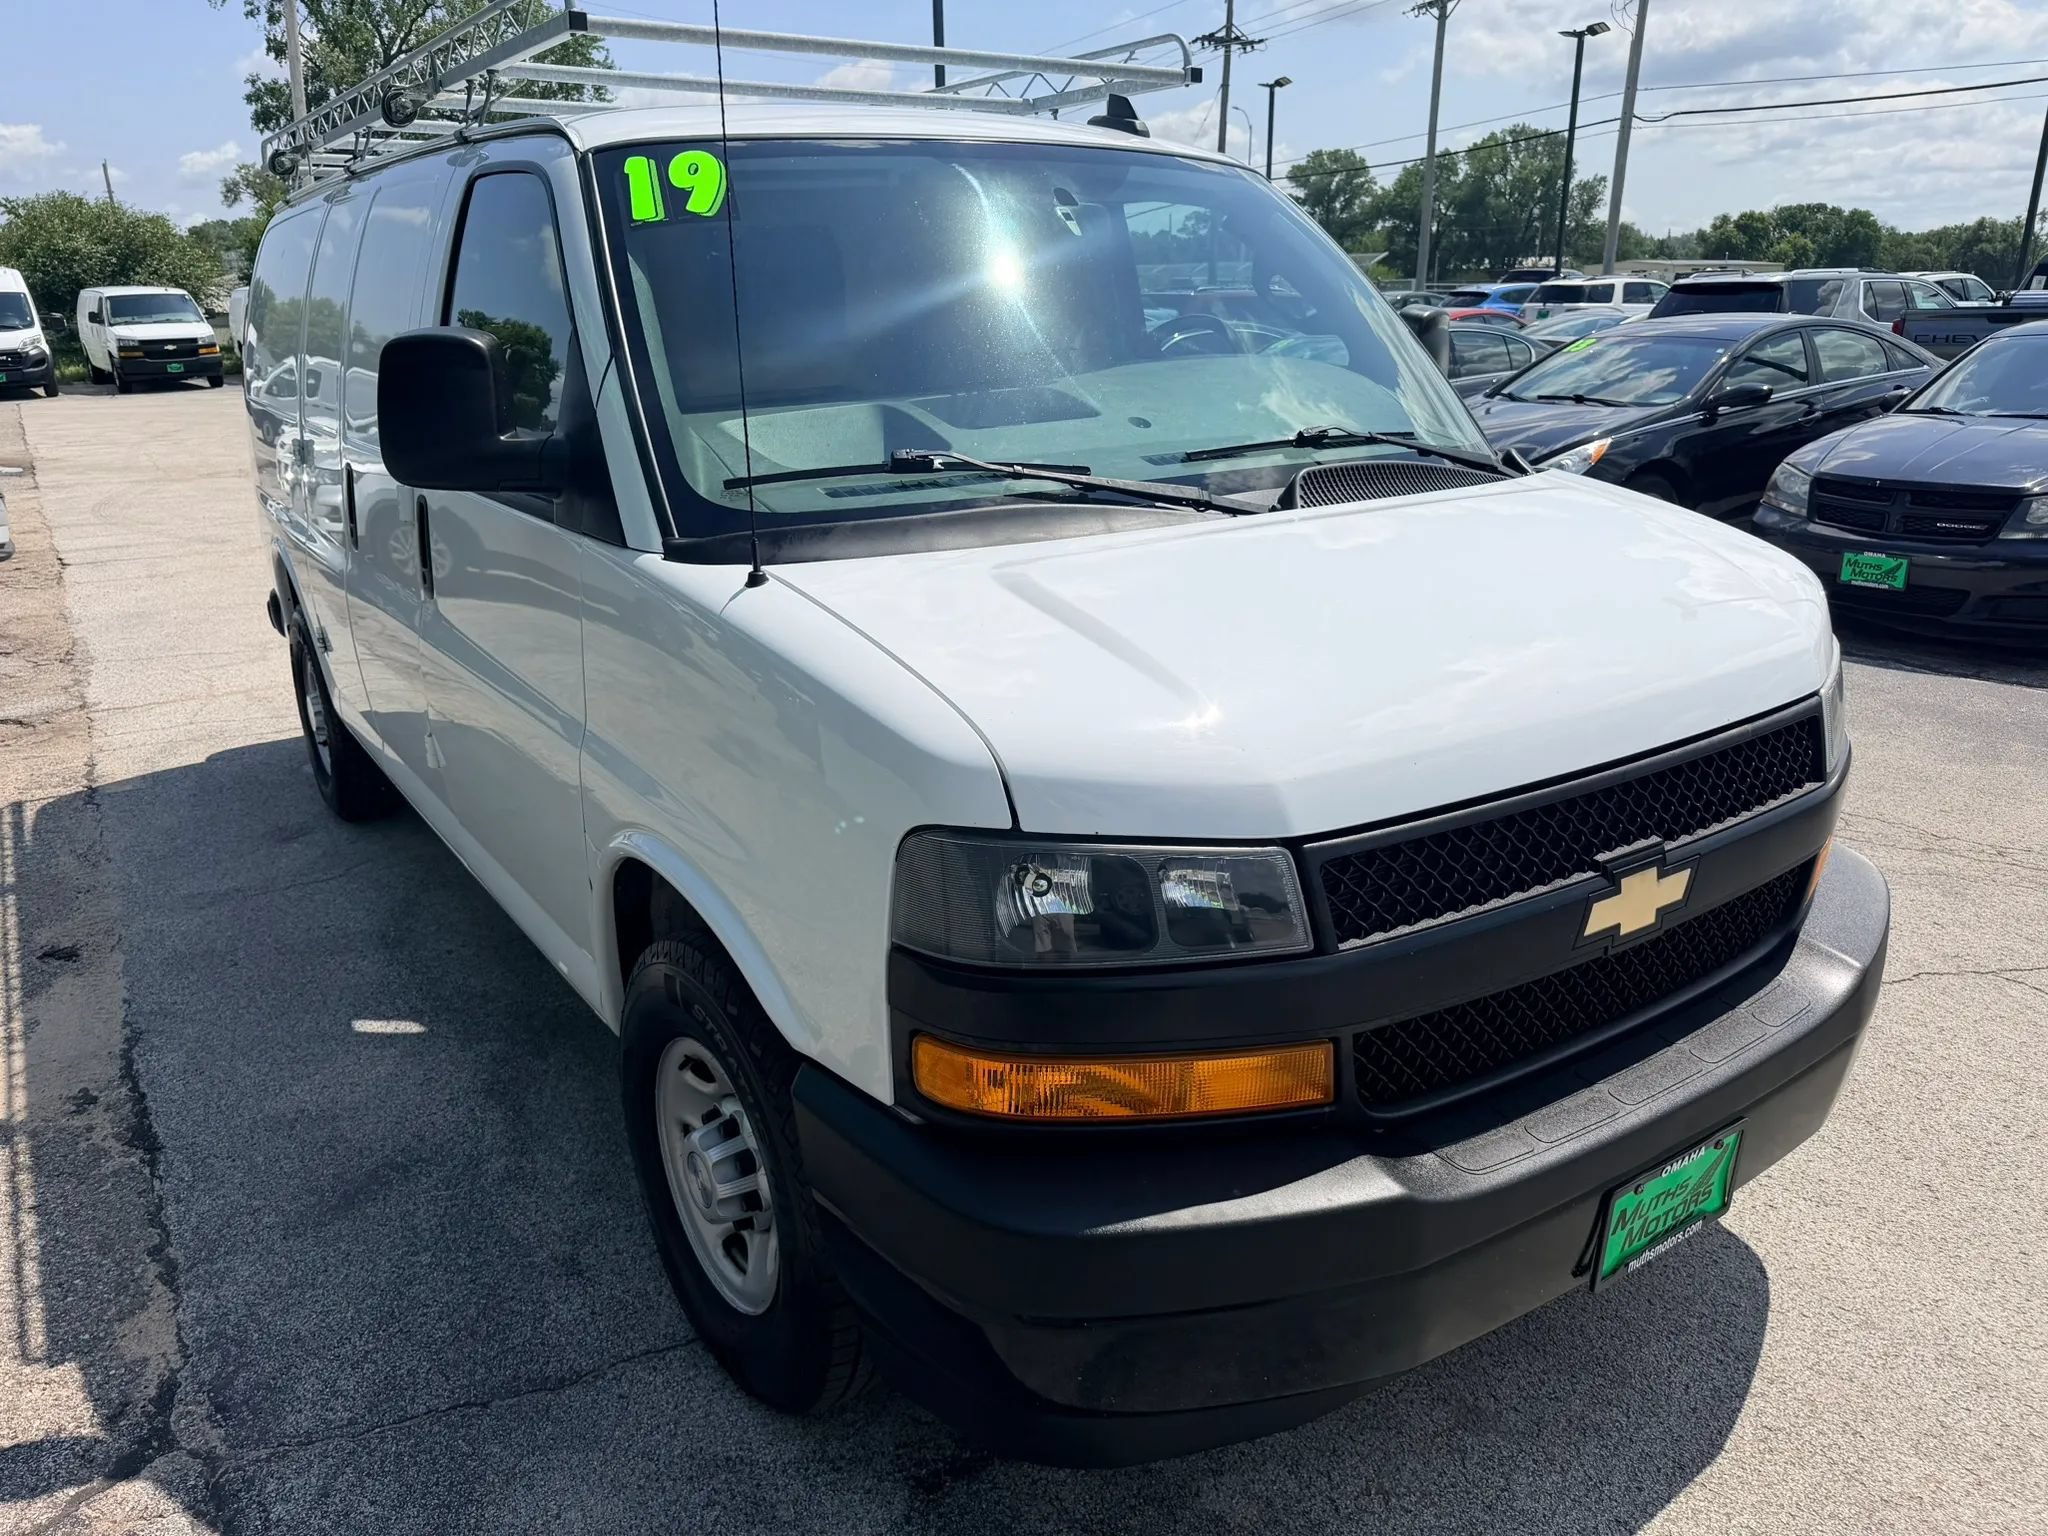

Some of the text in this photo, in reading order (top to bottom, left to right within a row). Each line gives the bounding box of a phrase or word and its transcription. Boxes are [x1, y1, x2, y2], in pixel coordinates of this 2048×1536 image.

[624, 150, 727, 222] 19
[1845, 558, 1883, 571] MUTHS
[1850, 569, 1898, 582] MOTORS
[1661, 1146, 1705, 1178] OMAHA
[1610, 1176, 1693, 1237] MUTHS
[1619, 1181, 1714, 1253] MOTORS
[1628, 1220, 1703, 1273] muthsmotors.com
